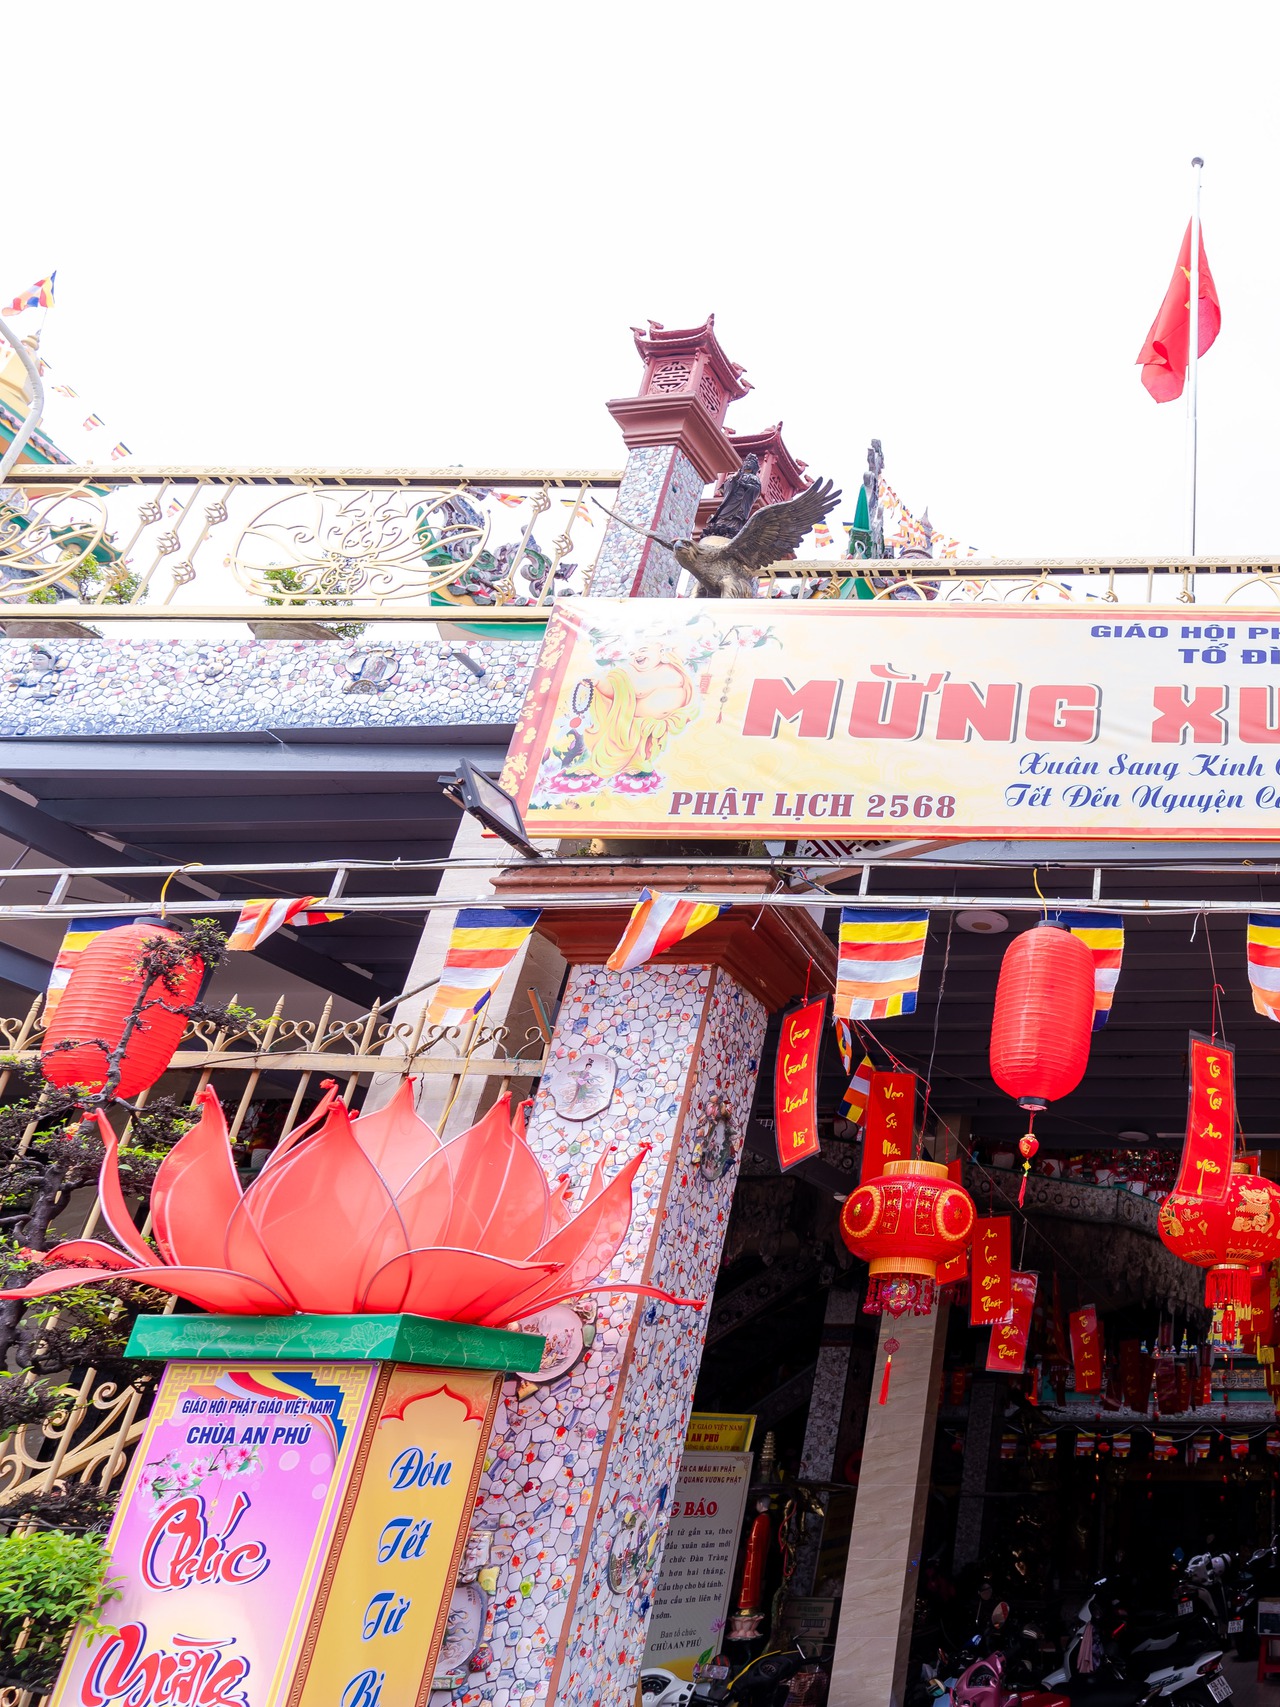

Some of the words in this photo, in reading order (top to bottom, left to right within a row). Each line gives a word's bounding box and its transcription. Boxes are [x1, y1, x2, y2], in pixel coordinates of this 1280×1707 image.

[1090, 623, 1169, 639] GIÁO
[1180, 624, 1236, 642] HỘI
[1178, 642, 1229, 665] TỔ
[743, 663, 1103, 743] MỪNG
[1018, 752, 1099, 778] Xuân
[1107, 753, 1180, 782] Sang
[1187, 753, 1264, 778] Kính
[669, 789, 763, 818] PHẬT
[774, 792, 853, 820] LỊCH
[867, 795, 956, 818] 2568
[1004, 781, 1054, 807] Tết
[1062, 785, 1122, 809] Đến
[1130, 785, 1246, 815] Nguyện
[182, 1400, 207, 1414] GIÁO
[208, 1400, 227, 1416] HỘI
[228, 1400, 257, 1416] PHẬT
[257, 1400, 283, 1414] GIÁO
[284, 1400, 308, 1416] VIỆT
[308, 1400, 334, 1414] NAM
[186, 1425, 236, 1445] CHÙA
[239, 1427, 270, 1445] AN
[271, 1421, 312, 1446] PHÚ
[691, 1433, 702, 1443] AN
[390, 1447, 452, 1490] Đón
[688, 1465, 697, 1473] CA
[720, 1465, 737, 1475] PHẬT
[683, 1476, 704, 1484] QUANG
[725, 1476, 742, 1485] PHẬT
[682, 1497, 718, 1517] BÁO
[377, 1517, 433, 1563] Tết
[718, 1527, 733, 1535] theo
[141, 1491, 271, 1591] Chúc
[681, 1541, 698, 1549] xuân
[687, 1568, 699, 1576] hai
[684, 1582, 697, 1590] cho
[362, 1592, 411, 1640] Từ
[650, 1641, 673, 1652] CHÙA
[672, 1640, 685, 1650] AN
[685, 1636, 702, 1647] PHÚ
[660, 1630, 673, 1639] Ban
